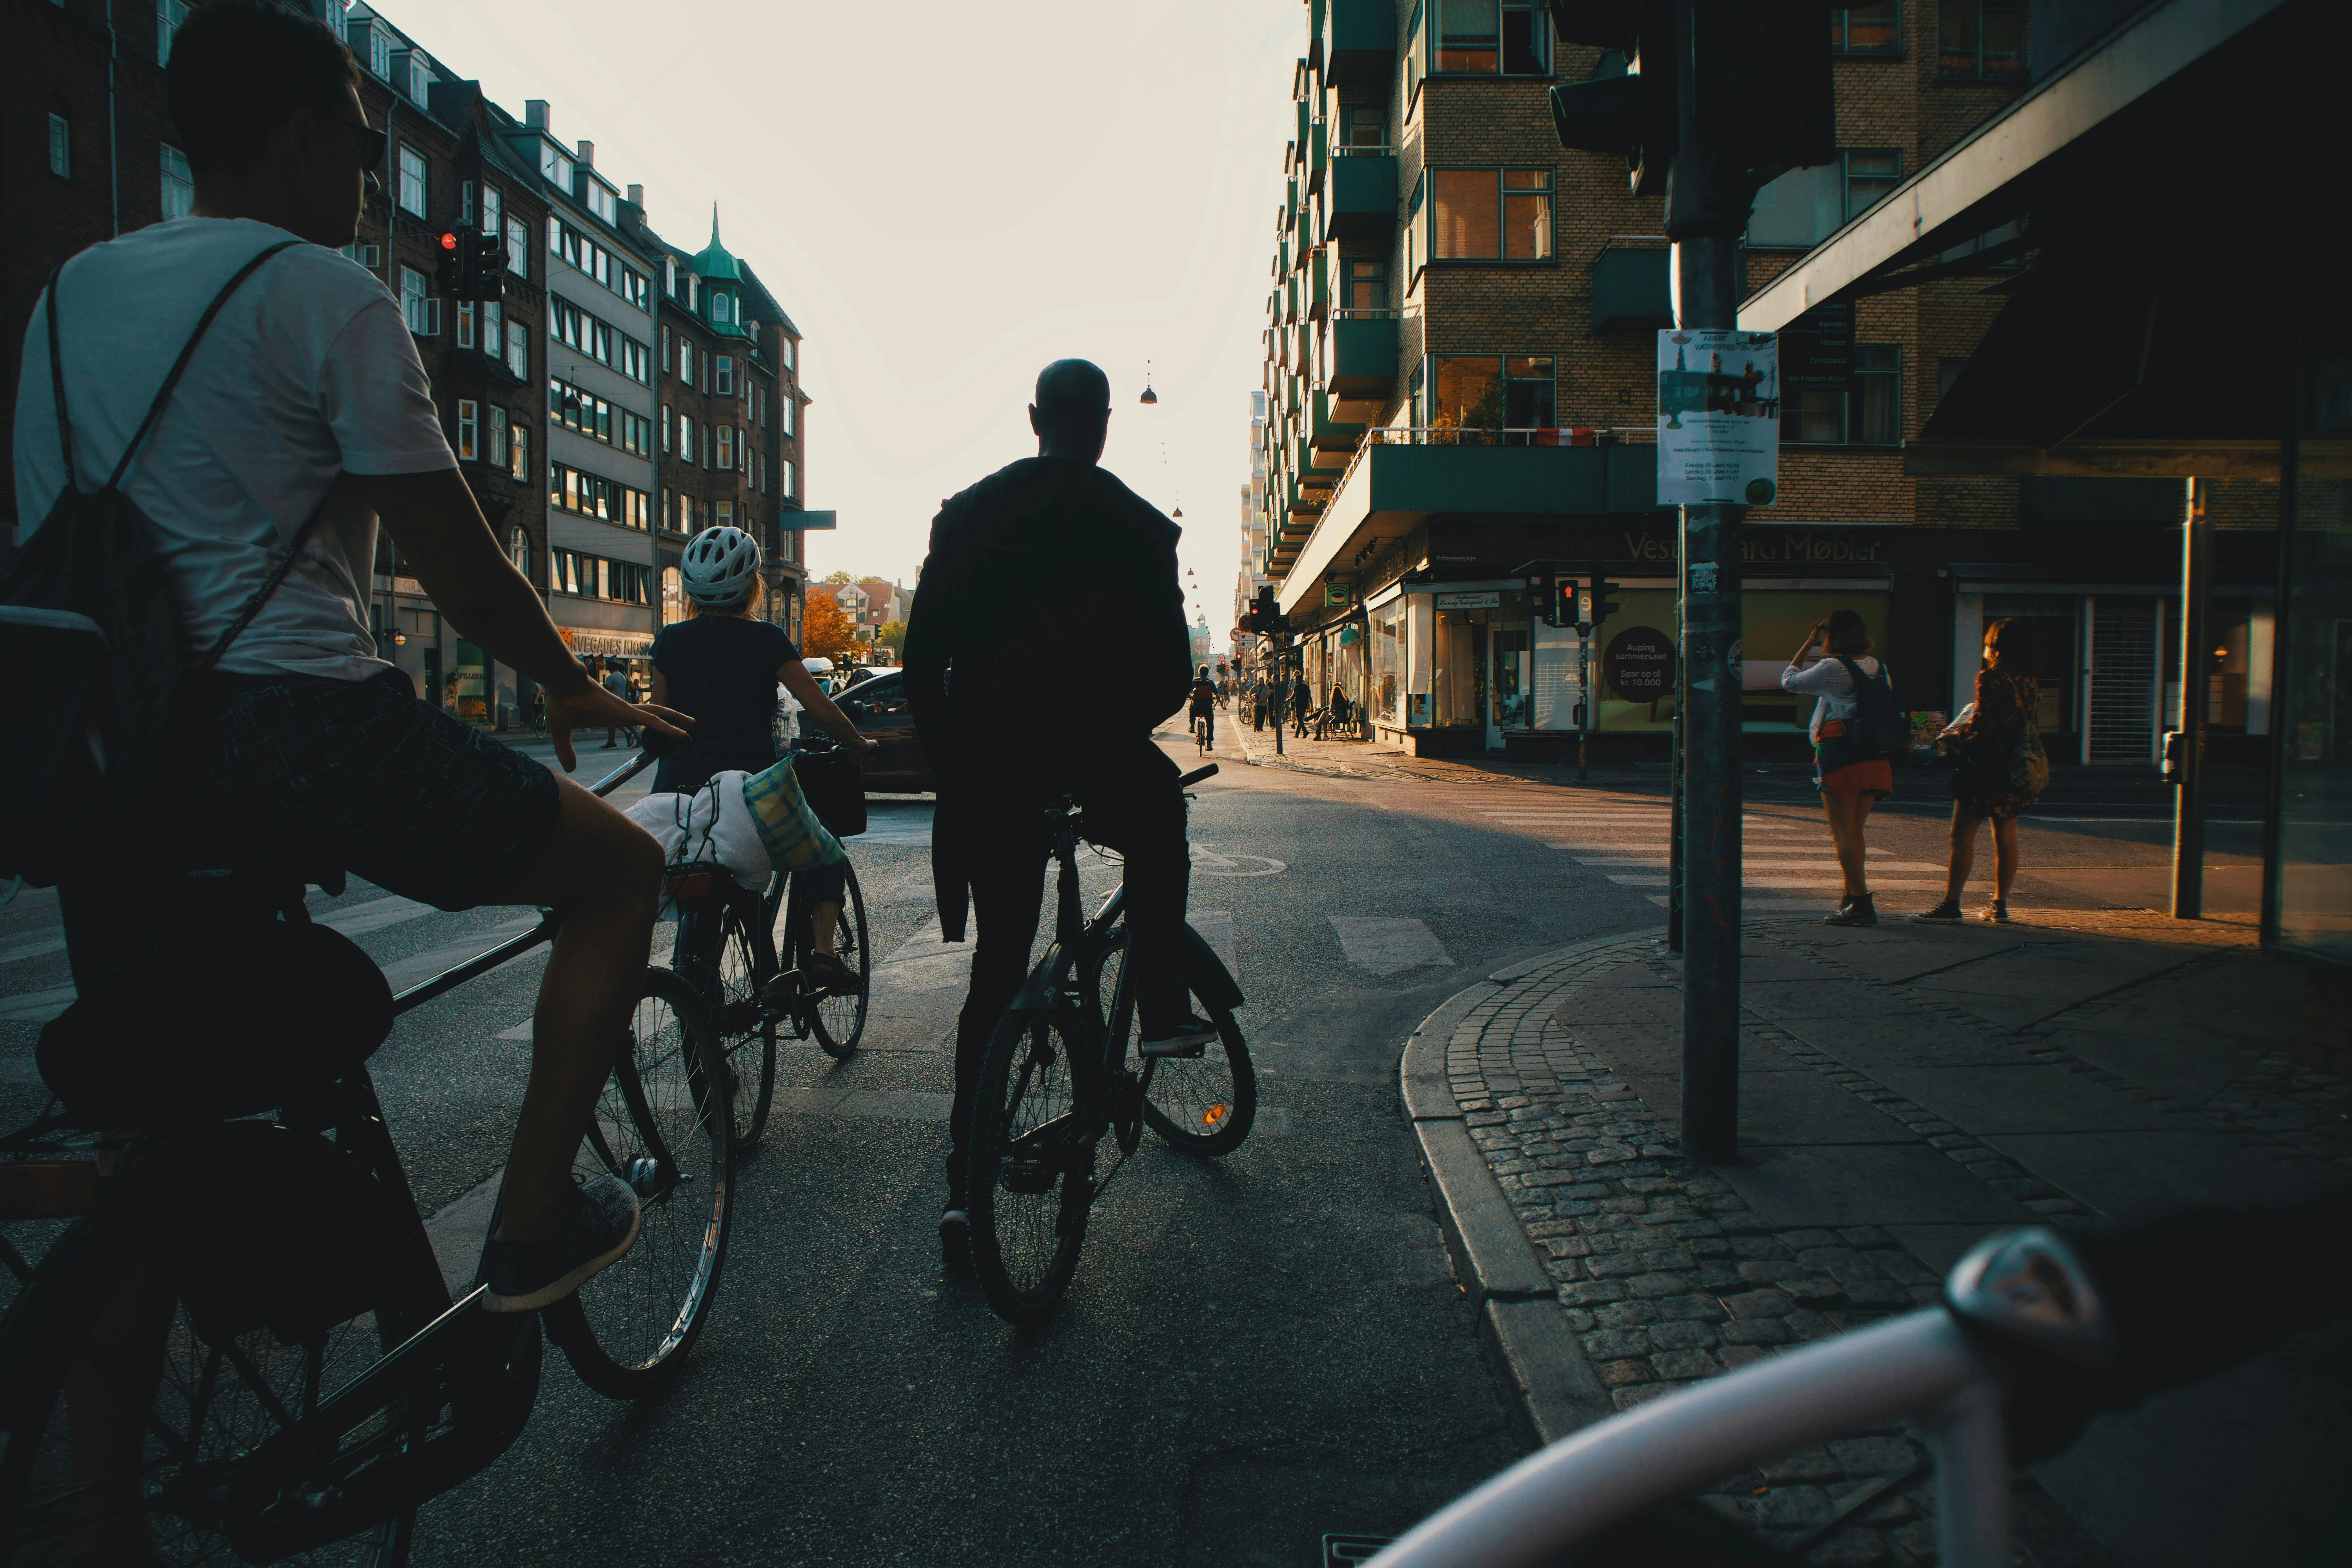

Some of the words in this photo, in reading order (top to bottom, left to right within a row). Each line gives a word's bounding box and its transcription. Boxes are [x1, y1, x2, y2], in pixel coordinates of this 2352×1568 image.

[1784, 531, 1882, 561] Møbler
[1626, 644, 1655, 653] Auping
[1620, 670, 1640, 679] Spar
[187, 868, 234, 878] WITTKOP
